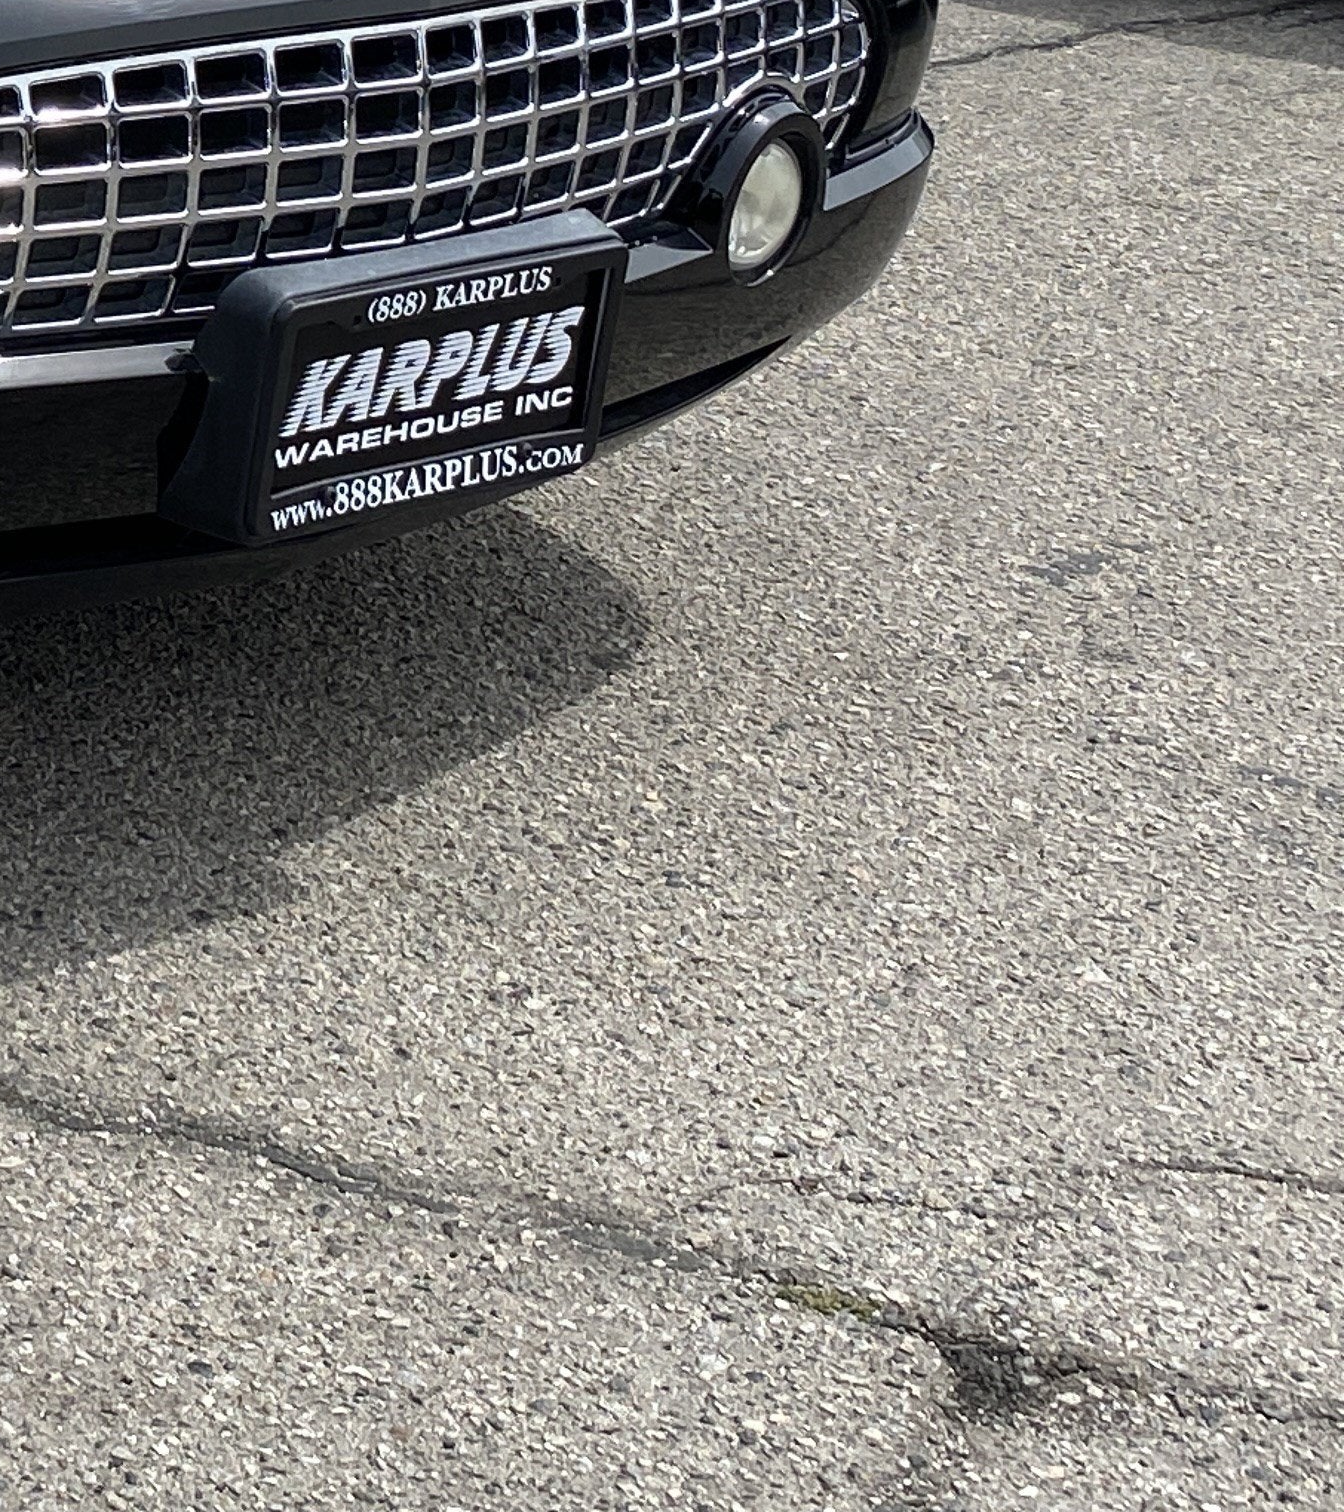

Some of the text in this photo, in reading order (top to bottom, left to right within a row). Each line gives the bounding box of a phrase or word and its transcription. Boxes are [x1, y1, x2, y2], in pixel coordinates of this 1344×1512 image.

[367, 266, 553, 323] (888) KARPLUS
[278, 306, 585, 438] KARPLUS
[274, 387, 573, 468] WAREHOUSE INC
